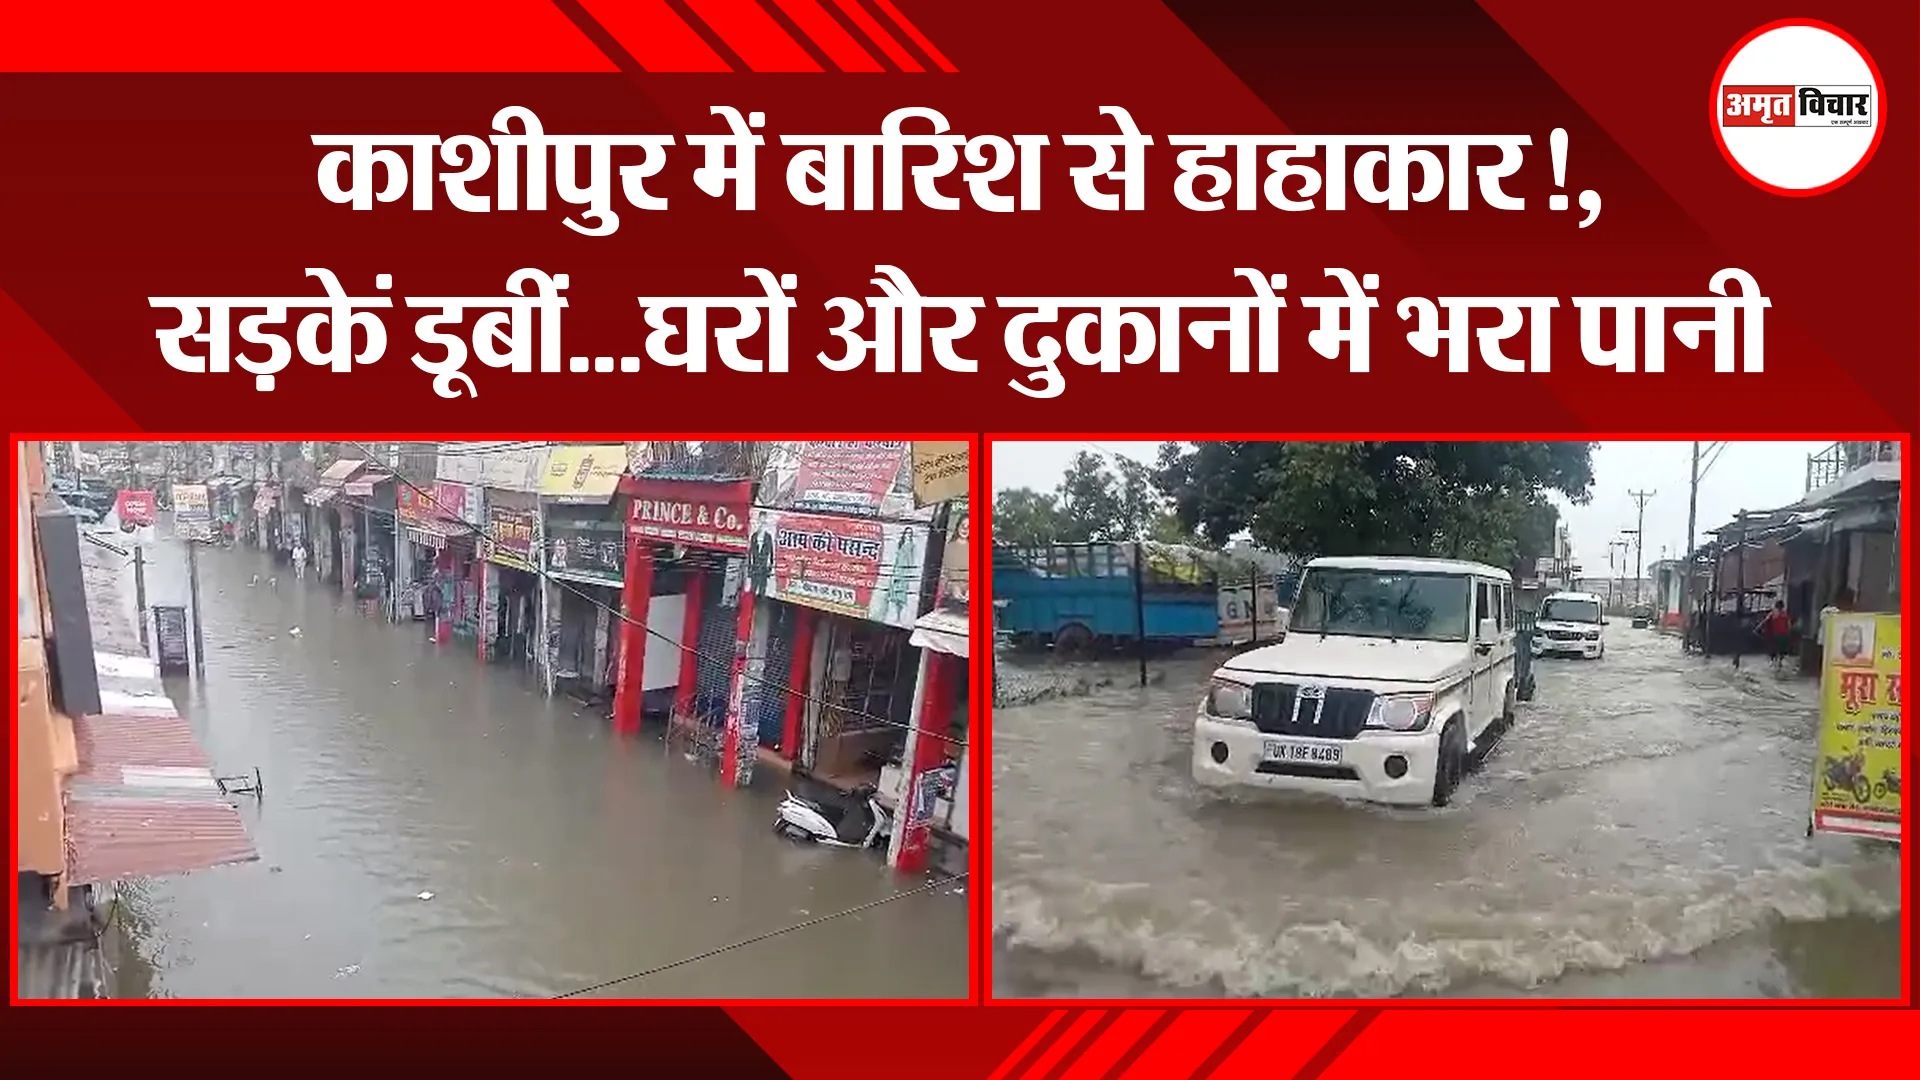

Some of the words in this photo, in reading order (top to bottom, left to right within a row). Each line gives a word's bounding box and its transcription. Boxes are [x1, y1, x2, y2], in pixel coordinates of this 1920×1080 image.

[632, 498, 693, 526] PRINCE
[696, 505, 710, 526] &
[713, 506, 744, 531] Co.
[778, 529, 809, 550] आप
[812, 529, 835, 554] की
